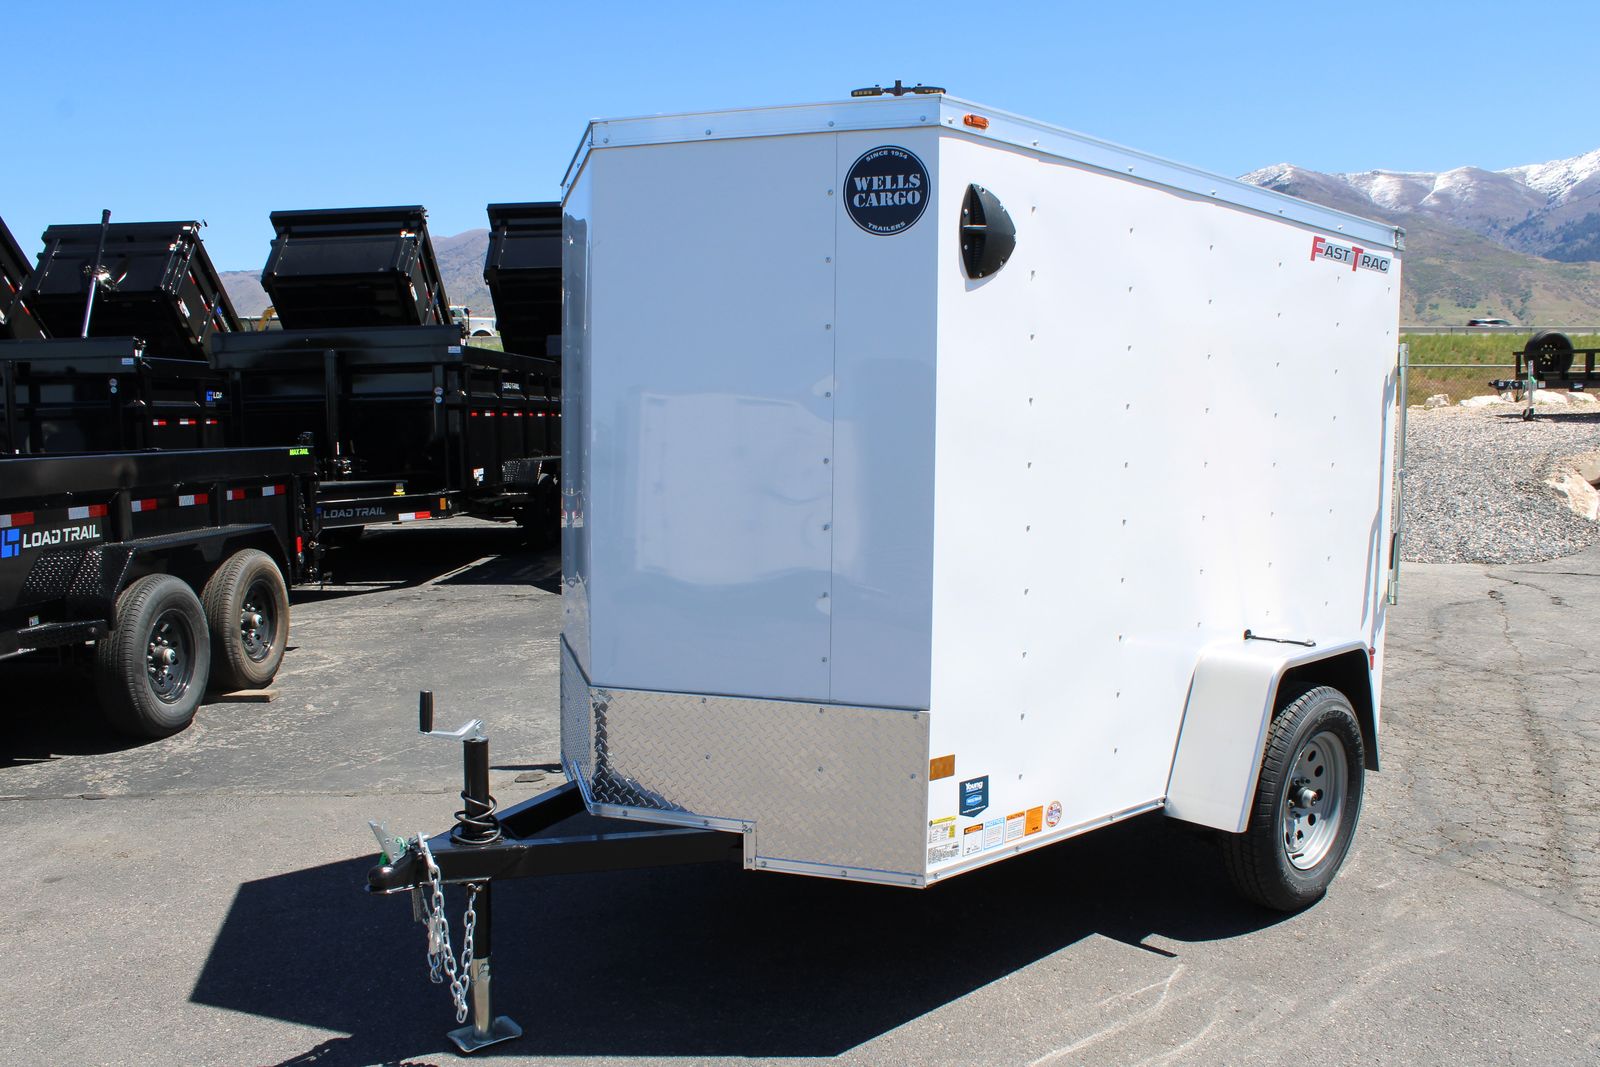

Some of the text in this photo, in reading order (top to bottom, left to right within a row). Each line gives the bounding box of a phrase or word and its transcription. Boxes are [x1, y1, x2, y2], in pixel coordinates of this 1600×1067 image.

[865, 150, 908, 162] SINCE 1954
[853, 173, 921, 192] WELLS
[853, 190, 922, 208] CARGO
[867, 221, 906, 231] TRAILERS
[1310, 236, 1388, 272] FAST TRAC
[323, 506, 387, 519] LOAD TRAIL
[22, 524, 100, 549] LOAD TRAIL
